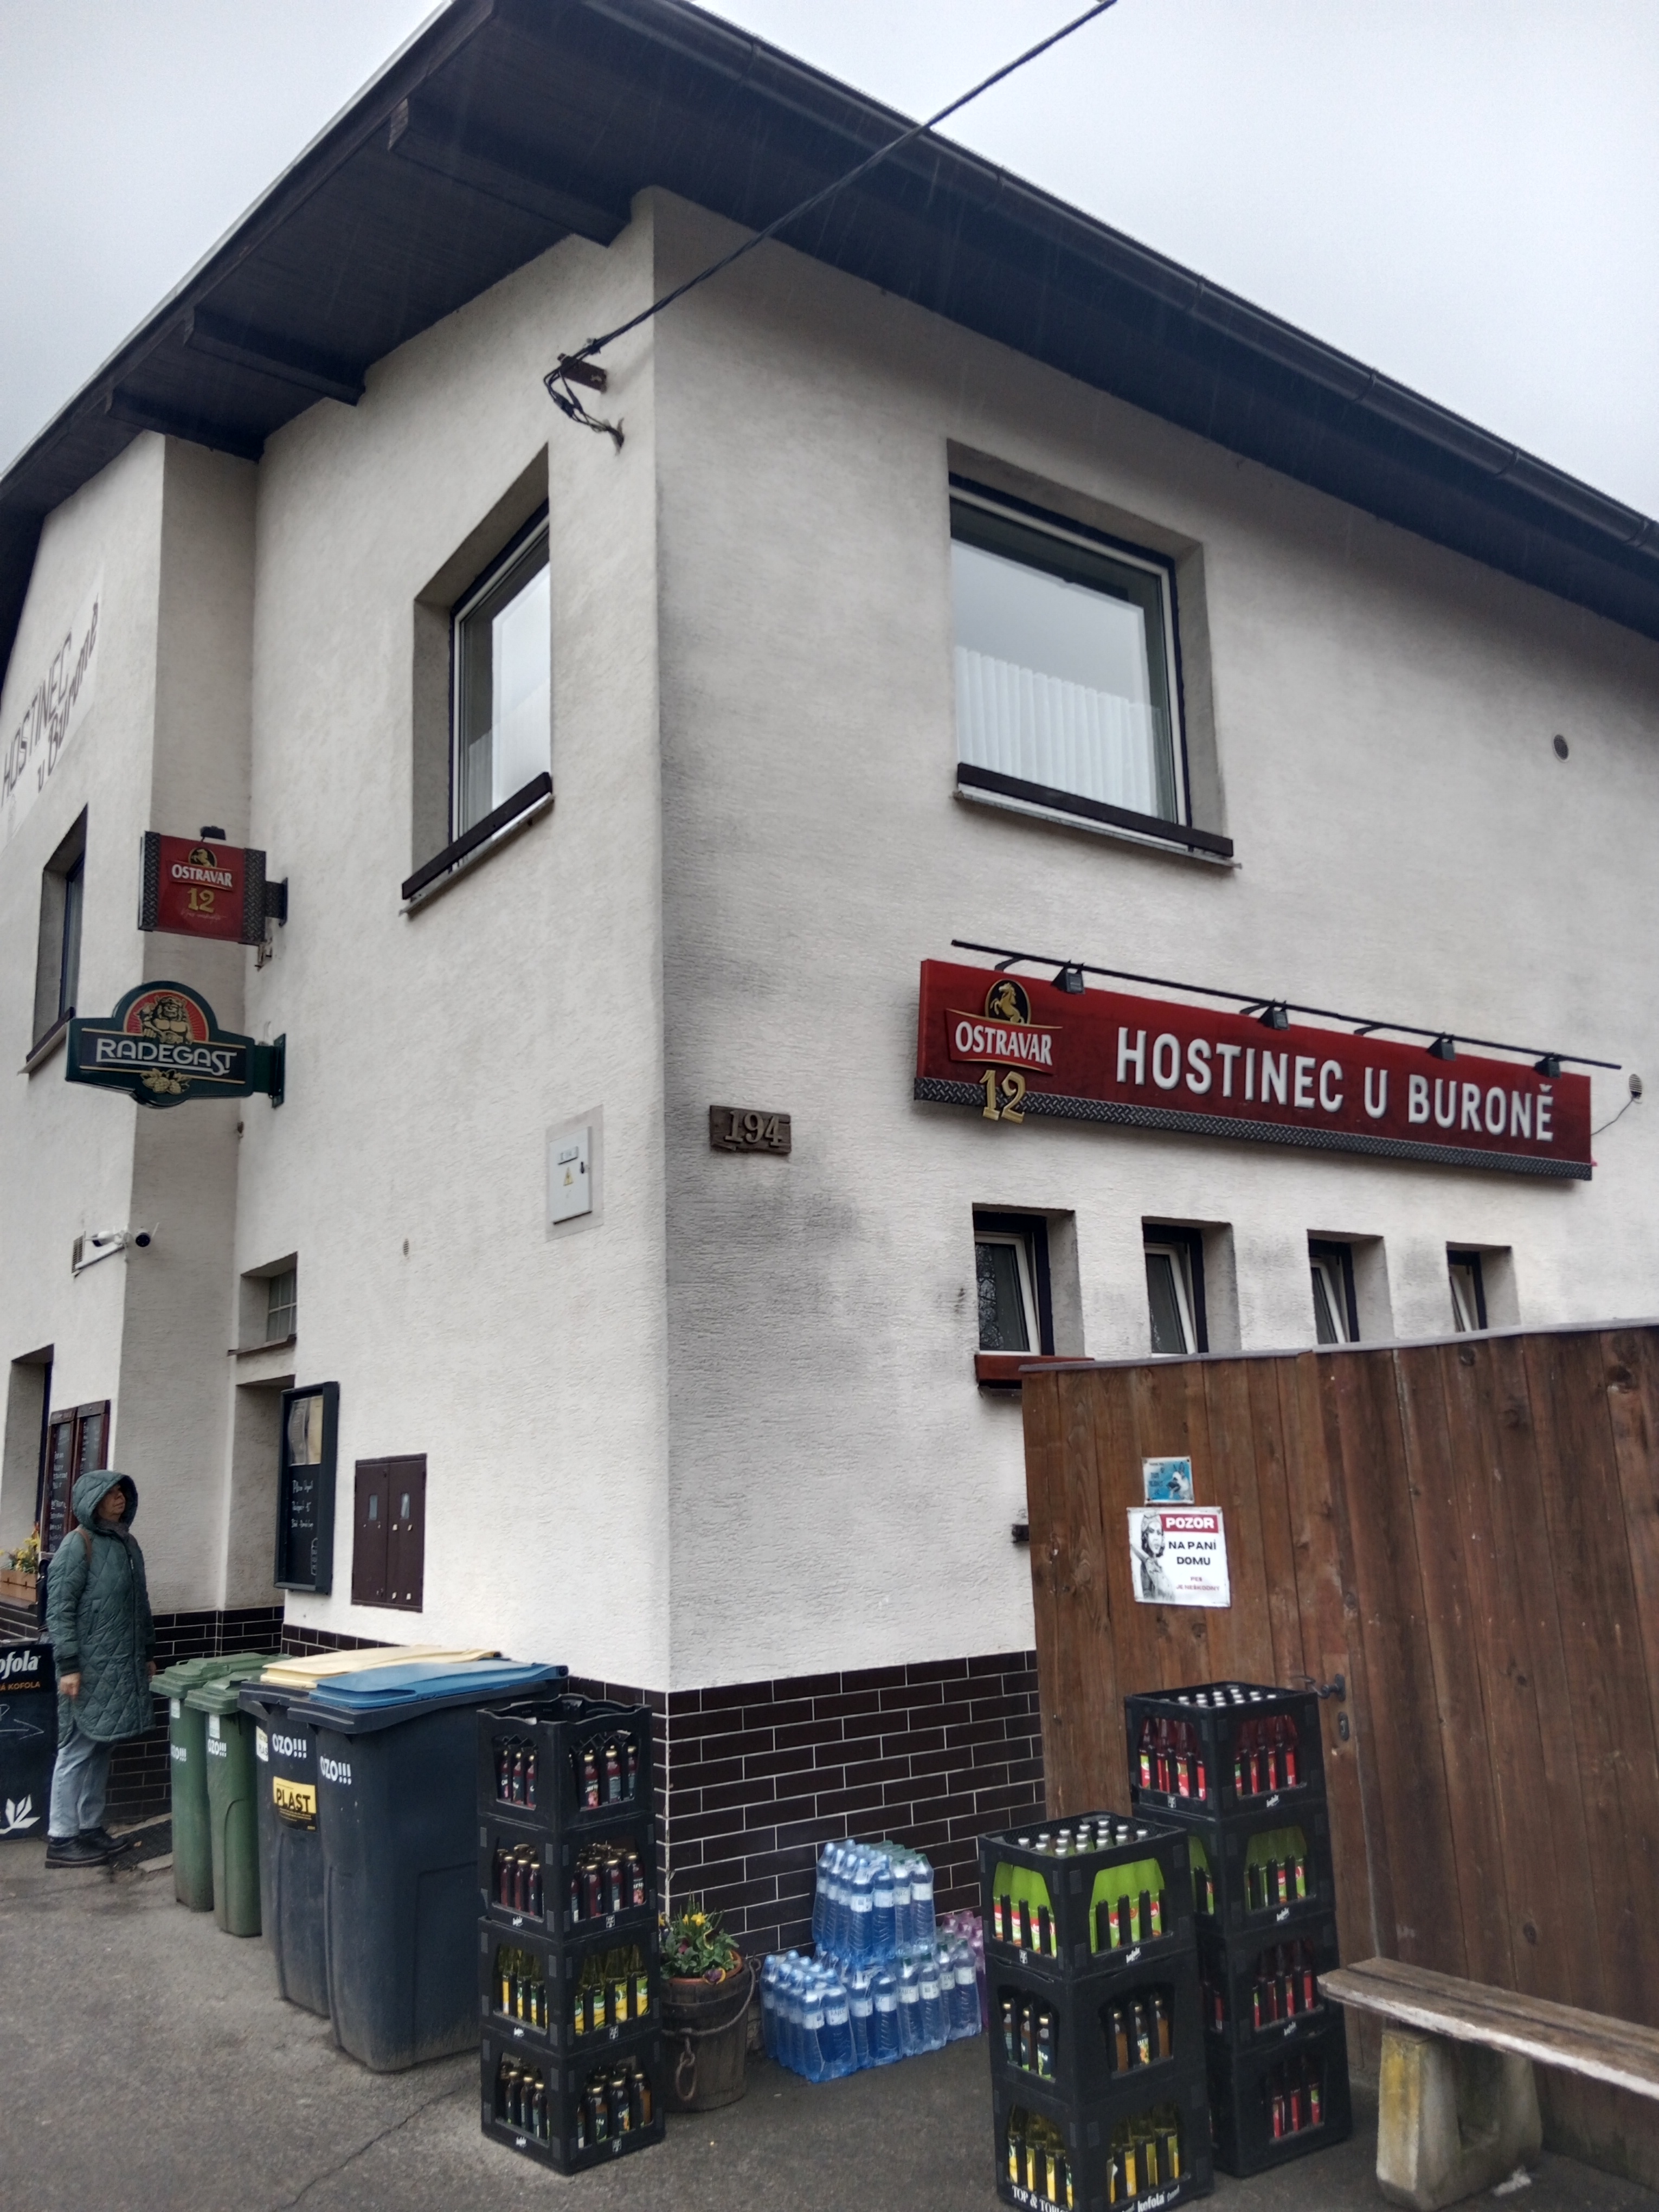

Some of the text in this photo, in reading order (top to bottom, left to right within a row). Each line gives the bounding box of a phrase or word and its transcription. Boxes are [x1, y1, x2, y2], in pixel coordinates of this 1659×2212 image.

[1, 627, 72, 808] HOSTINEC
[171, 864, 233, 888] OSTRAVAR
[187, 888, 215, 913] 12
[955, 1020, 1053, 1066] OSTRAVAR
[96, 1038, 237, 1076] RADEGAST
[1116, 1026, 1554, 1142] HOSTINEC U BURONĚ
[978, 1069, 1026, 1125] 12
[725, 1110, 790, 1147] 194
[1166, 1516, 1214, 1529] POZOR
[1168, 1539, 1217, 1550] NA PANÍ
[1176, 1557, 1211, 1566] DOMU
[8, 1681, 41, 1690] KOFOLA
[208, 1738, 227, 1757] OZO!!!
[273, 1733, 307, 1758] OZO!!!
[320, 1756, 352, 1785] OZO!!!
[276, 1788, 311, 1814] PLAST
[1012, 2185, 1068, 2212] TOP & TOPI
[1137, 2192, 1165, 2212] kofola
